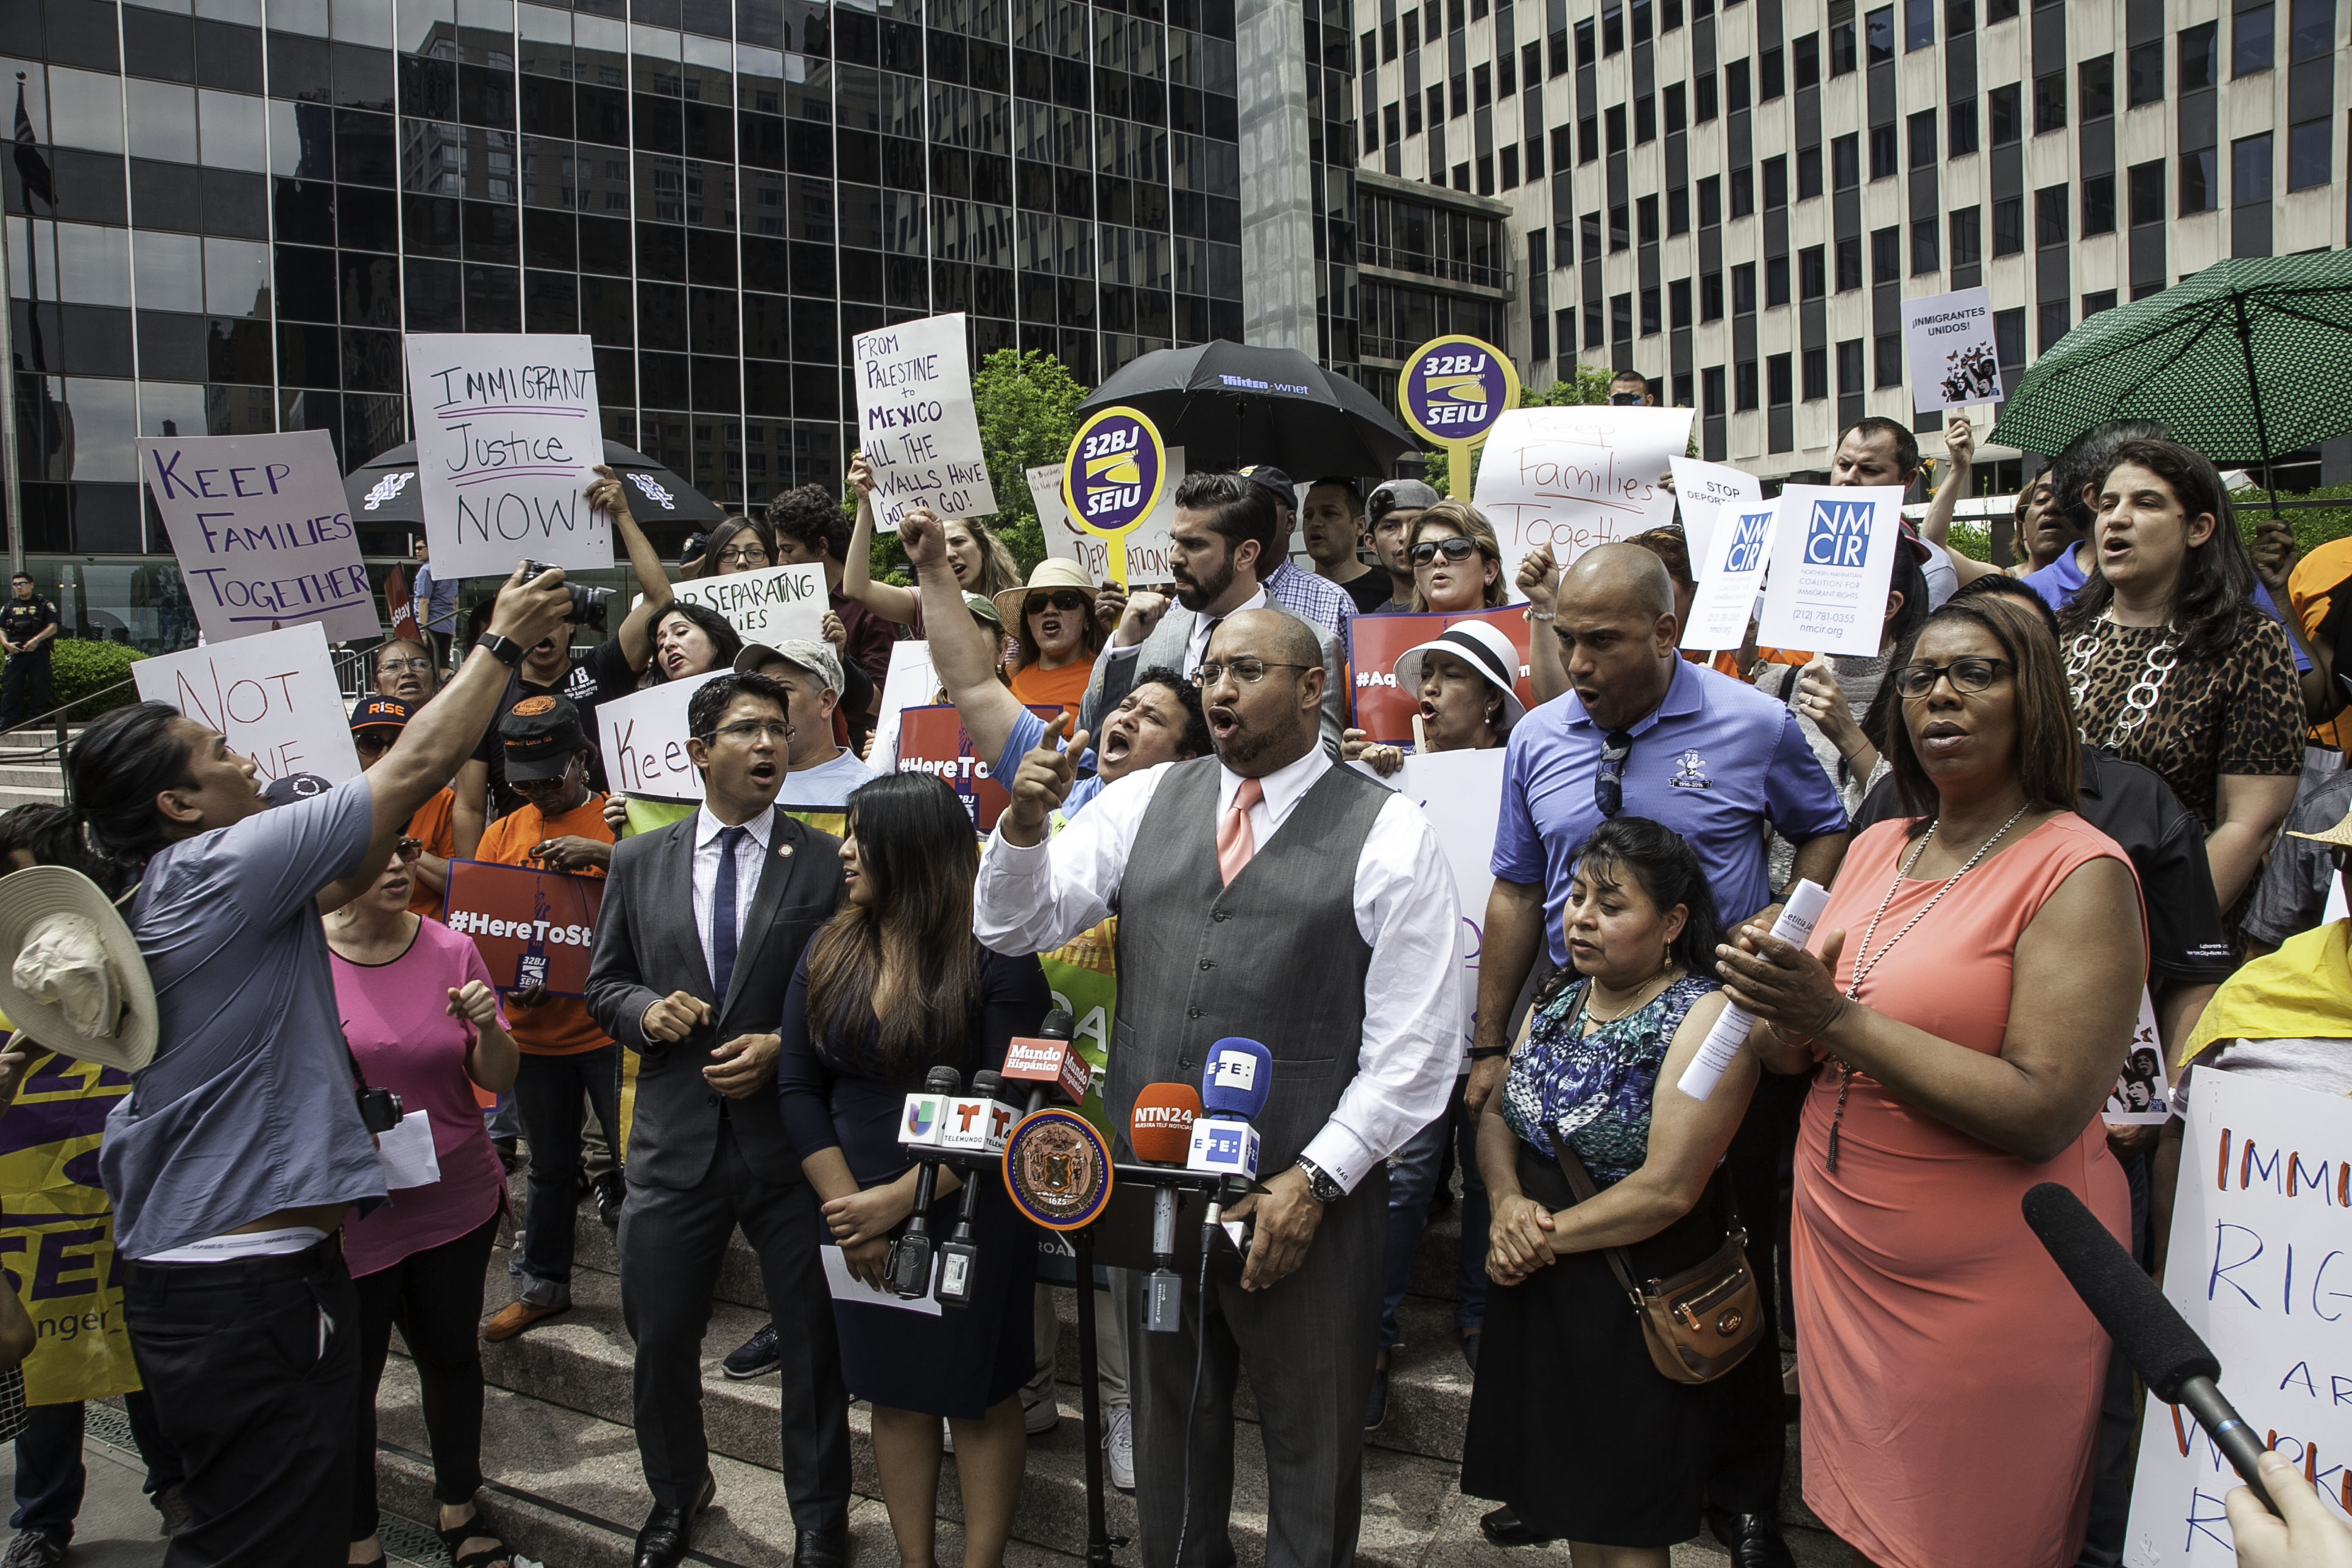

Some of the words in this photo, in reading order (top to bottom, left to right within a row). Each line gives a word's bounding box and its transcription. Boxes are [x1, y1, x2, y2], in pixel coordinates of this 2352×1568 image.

[1928, 322, 1970, 336] UNIDOS!
[857, 334, 899, 360] FROM
[866, 354, 939, 389] PALESTINE
[1423, 354, 1486, 375] 32BJ
[430, 366, 595, 409] IMMIGRANT
[902, 387, 915, 398] to
[1274, 383, 1309, 395] wnet
[869, 401, 942, 430] MEXICO
[1426, 404, 1488, 425] SEIU
[446, 423, 573, 471] Justice
[864, 439, 897, 467] ALL
[899, 433, 938, 464] THE
[1084, 426, 1139, 459] 32BJ
[152, 449, 291, 500] KEEP
[874, 470, 942, 498] WALLS
[947, 463, 985, 486] HAVE
[1513, 445, 1653, 501] Families
[939, 490, 973, 513] GO!
[1086, 485, 1141, 516] SEIU
[1706, 481, 1740, 498] STOP
[196, 512, 353, 553] FAMILIES
[1811, 503, 1870, 535] NM
[1486, 503, 1622, 571] Togeth
[1809, 533, 1862, 566] CIR
[189, 565, 370, 613] TOGETHER
[1797, 588, 1835, 598] IMMIGRANT
[1799, 578, 1842, 588] COALITION
[1793, 610, 1813, 621] (212)
[1815, 612, 1855, 624] 781-0355
[1799, 623, 1843, 638] nmcir.org
[177, 657, 299, 740] NOT
[899, 756, 990, 779] #HereTo
[1684, 754, 1698, 763] 78
[448, 910, 592, 947] #HereToSt
[1783, 909, 1806, 927] Letitia
[1805, 921, 1814, 931] Ja
[523, 956, 546, 966] 32BJ
[1006, 1058, 1059, 1072] Hispánico
[1010, 1045, 1062, 1062] Mundo
[1062, 1065, 1084, 1096] Hispánico
[1065, 1052, 1087, 1086] Mundo
[1135, 1107, 1193, 1124] NTN24
[2217, 1128, 2352, 1209] IMMI
[2208, 1218, 2352, 1321] RIG
